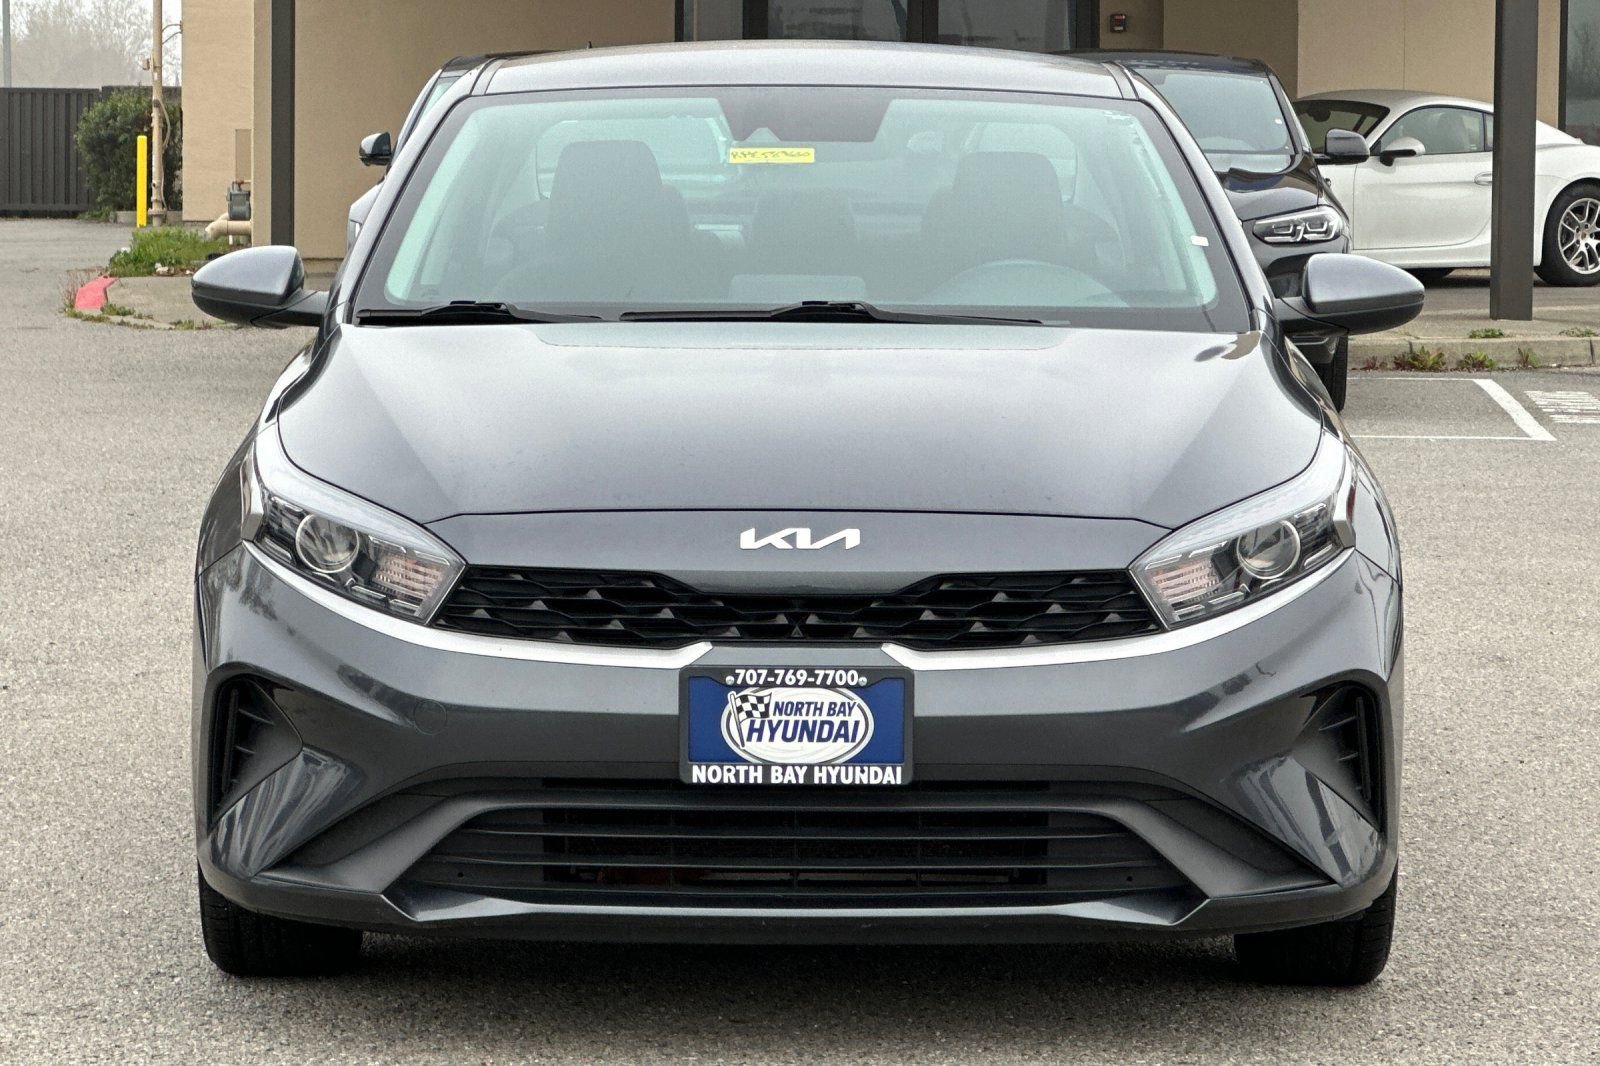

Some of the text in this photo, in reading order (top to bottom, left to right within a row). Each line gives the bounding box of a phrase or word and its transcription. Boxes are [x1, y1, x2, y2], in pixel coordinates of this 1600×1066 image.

[740, 527, 860, 549] KIA
[735, 669, 859, 686] 707-769-7700
[772, 701, 856, 717] NORTH BAY
[746, 719, 861, 743] HYUNDAI
[692, 765, 902, 784] NORTH BAY HYUNDAI
